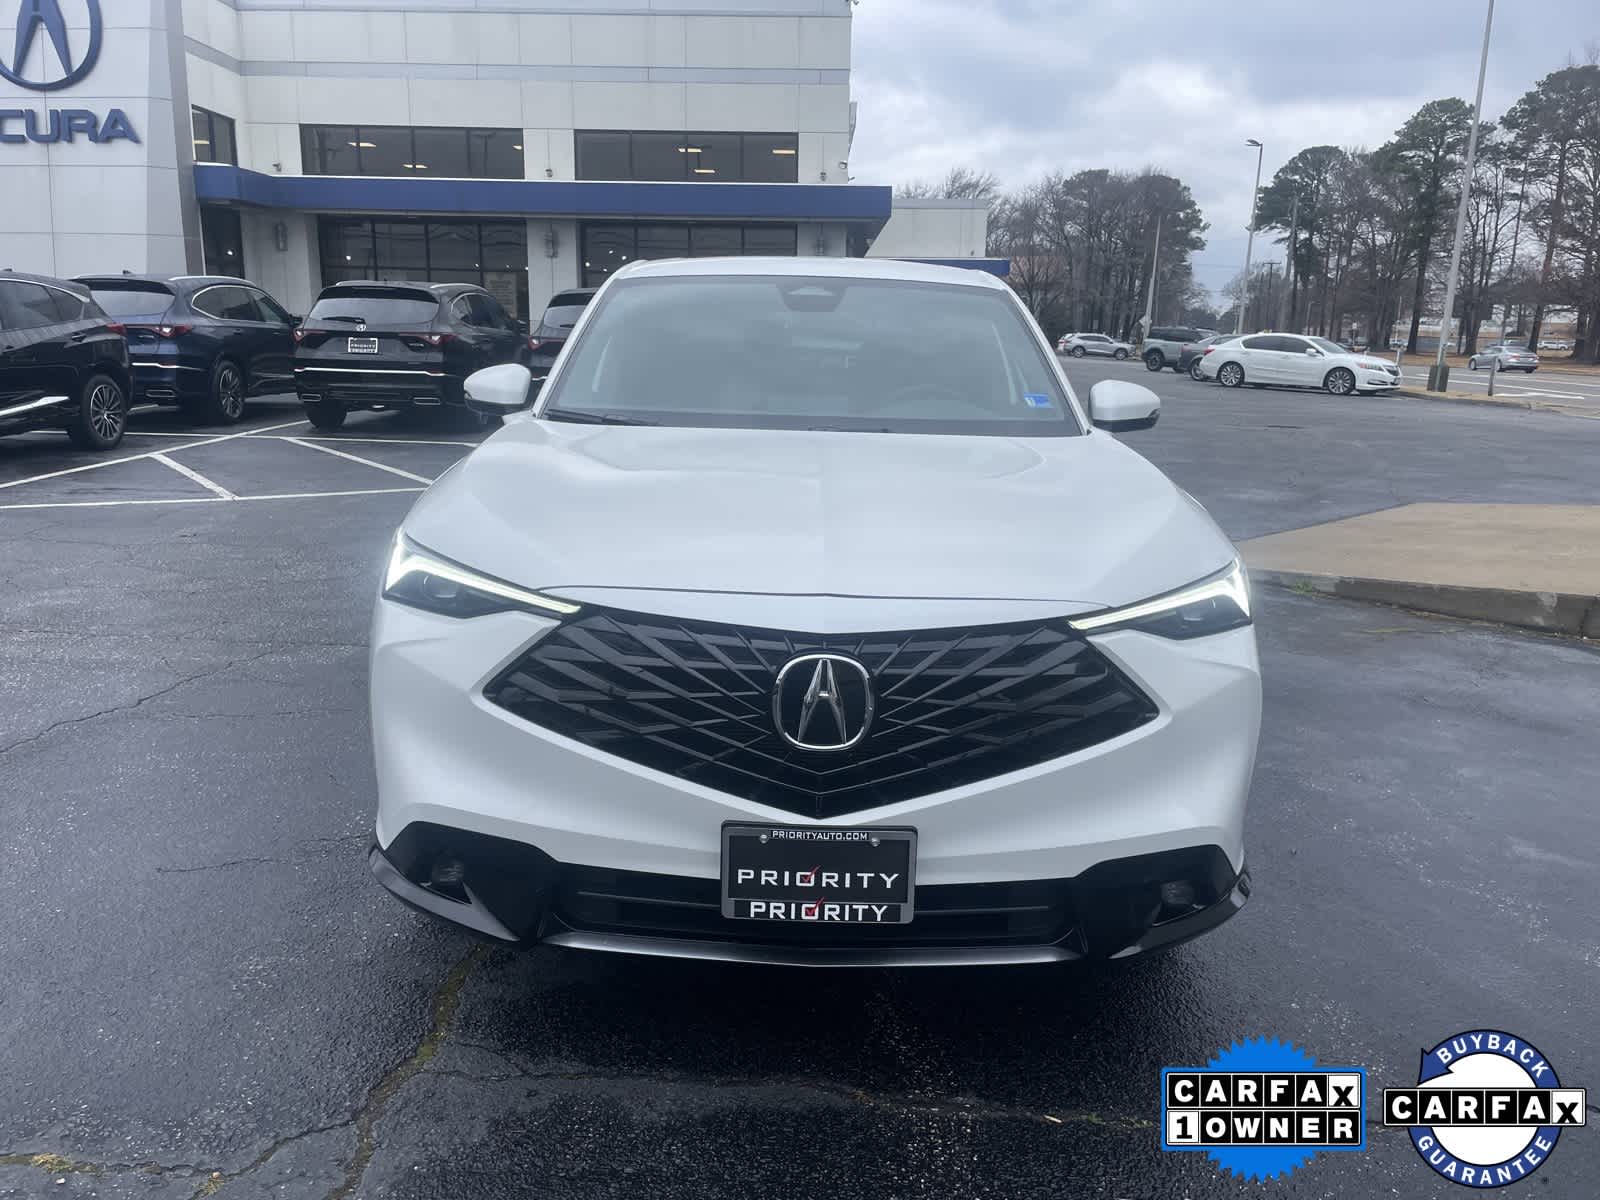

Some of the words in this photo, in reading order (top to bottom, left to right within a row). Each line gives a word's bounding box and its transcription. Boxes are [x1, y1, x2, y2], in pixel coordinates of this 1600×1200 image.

[772, 830, 868, 841] PRIORITYAUTO.COM
[737, 868, 900, 889] PRIORITY
[749, 901, 889, 922] PRIORITY
